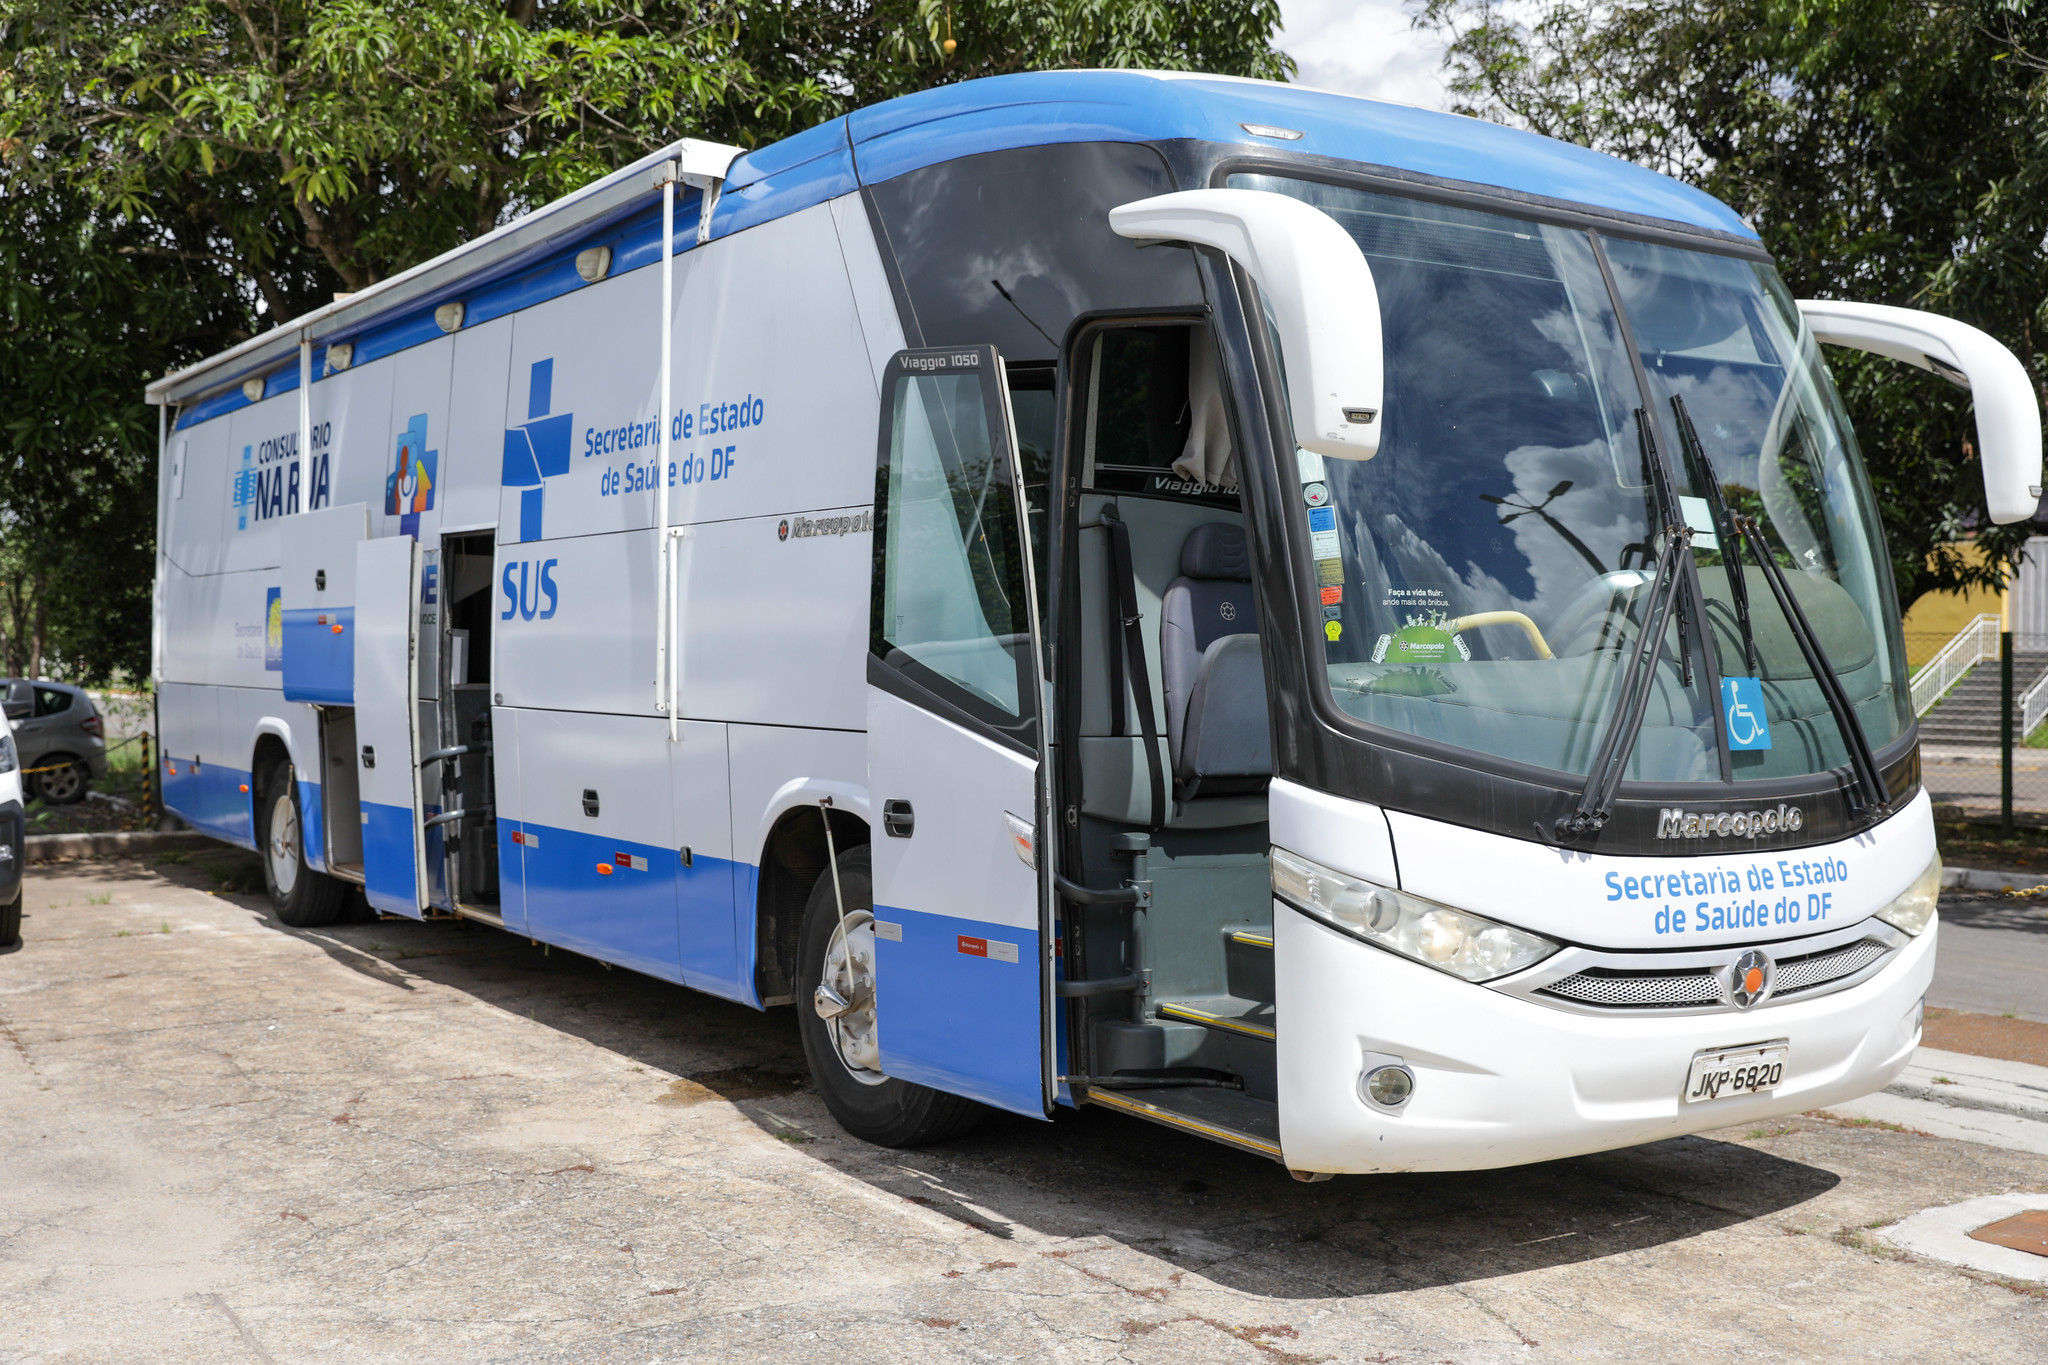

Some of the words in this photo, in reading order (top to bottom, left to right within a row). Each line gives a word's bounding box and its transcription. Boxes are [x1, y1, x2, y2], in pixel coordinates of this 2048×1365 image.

[900, 355, 946, 371] Viaggio
[951, 354, 979, 367] 1050
[672, 408, 693, 441] de
[699, 394, 764, 436] Estado
[259, 421, 331, 465] CONSULRIO
[601, 466, 620, 497] de
[682, 452, 705, 485] do
[710, 445, 736, 481] DF
[255, 466, 282, 521] NA
[501, 558, 558, 622] SUS
[1388, 588, 1405, 597] Faça
[1412, 588, 1426, 596] vida
[1410, 642, 1444, 650] Marcopolo
[1657, 803, 1803, 839] Marcopolo
[1605, 866, 1741, 901] Secretaria
[1746, 864, 1774, 892] de
[1777, 856, 1848, 889] Estado
[1655, 905, 1686, 934] de
[1695, 899, 1769, 932] Saúde
[1774, 896, 1801, 923] do
[1808, 892, 1832, 921] DF
